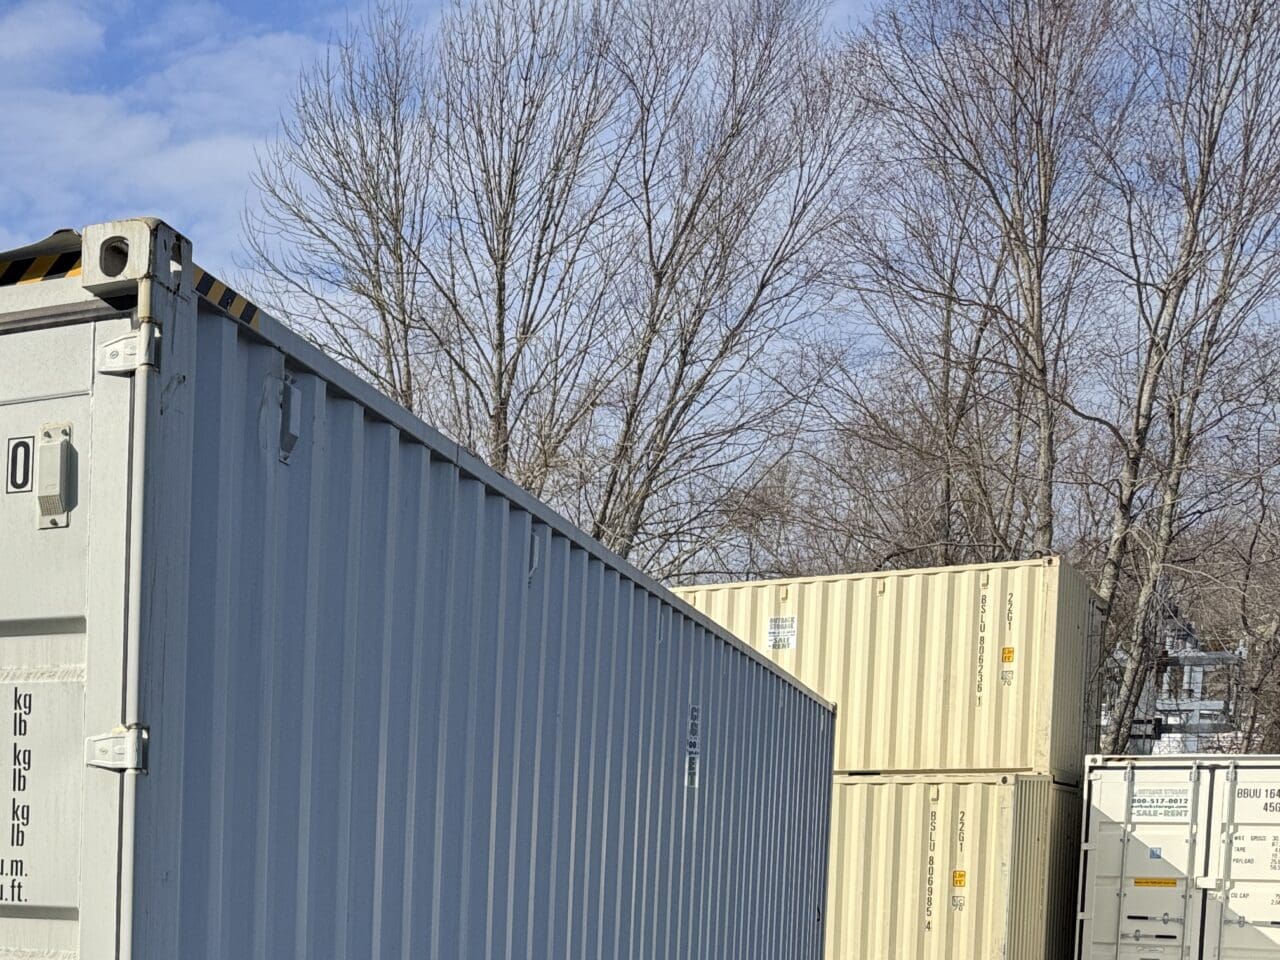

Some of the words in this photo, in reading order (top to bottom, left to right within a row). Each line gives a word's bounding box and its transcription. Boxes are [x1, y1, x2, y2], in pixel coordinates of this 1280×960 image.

[10, 440, 31, 490] 0
[977, 636, 985, 693] 806236
[14, 687, 32, 715] kg
[13, 712, 27, 737] lb
[13, 742, 31, 771] kg
[12, 768, 26, 792] lb
[11, 797, 30, 827] kg
[11, 823, 25, 847] lb
[926, 856, 934, 916] 806985
[926, 921, 931, 931] 4
